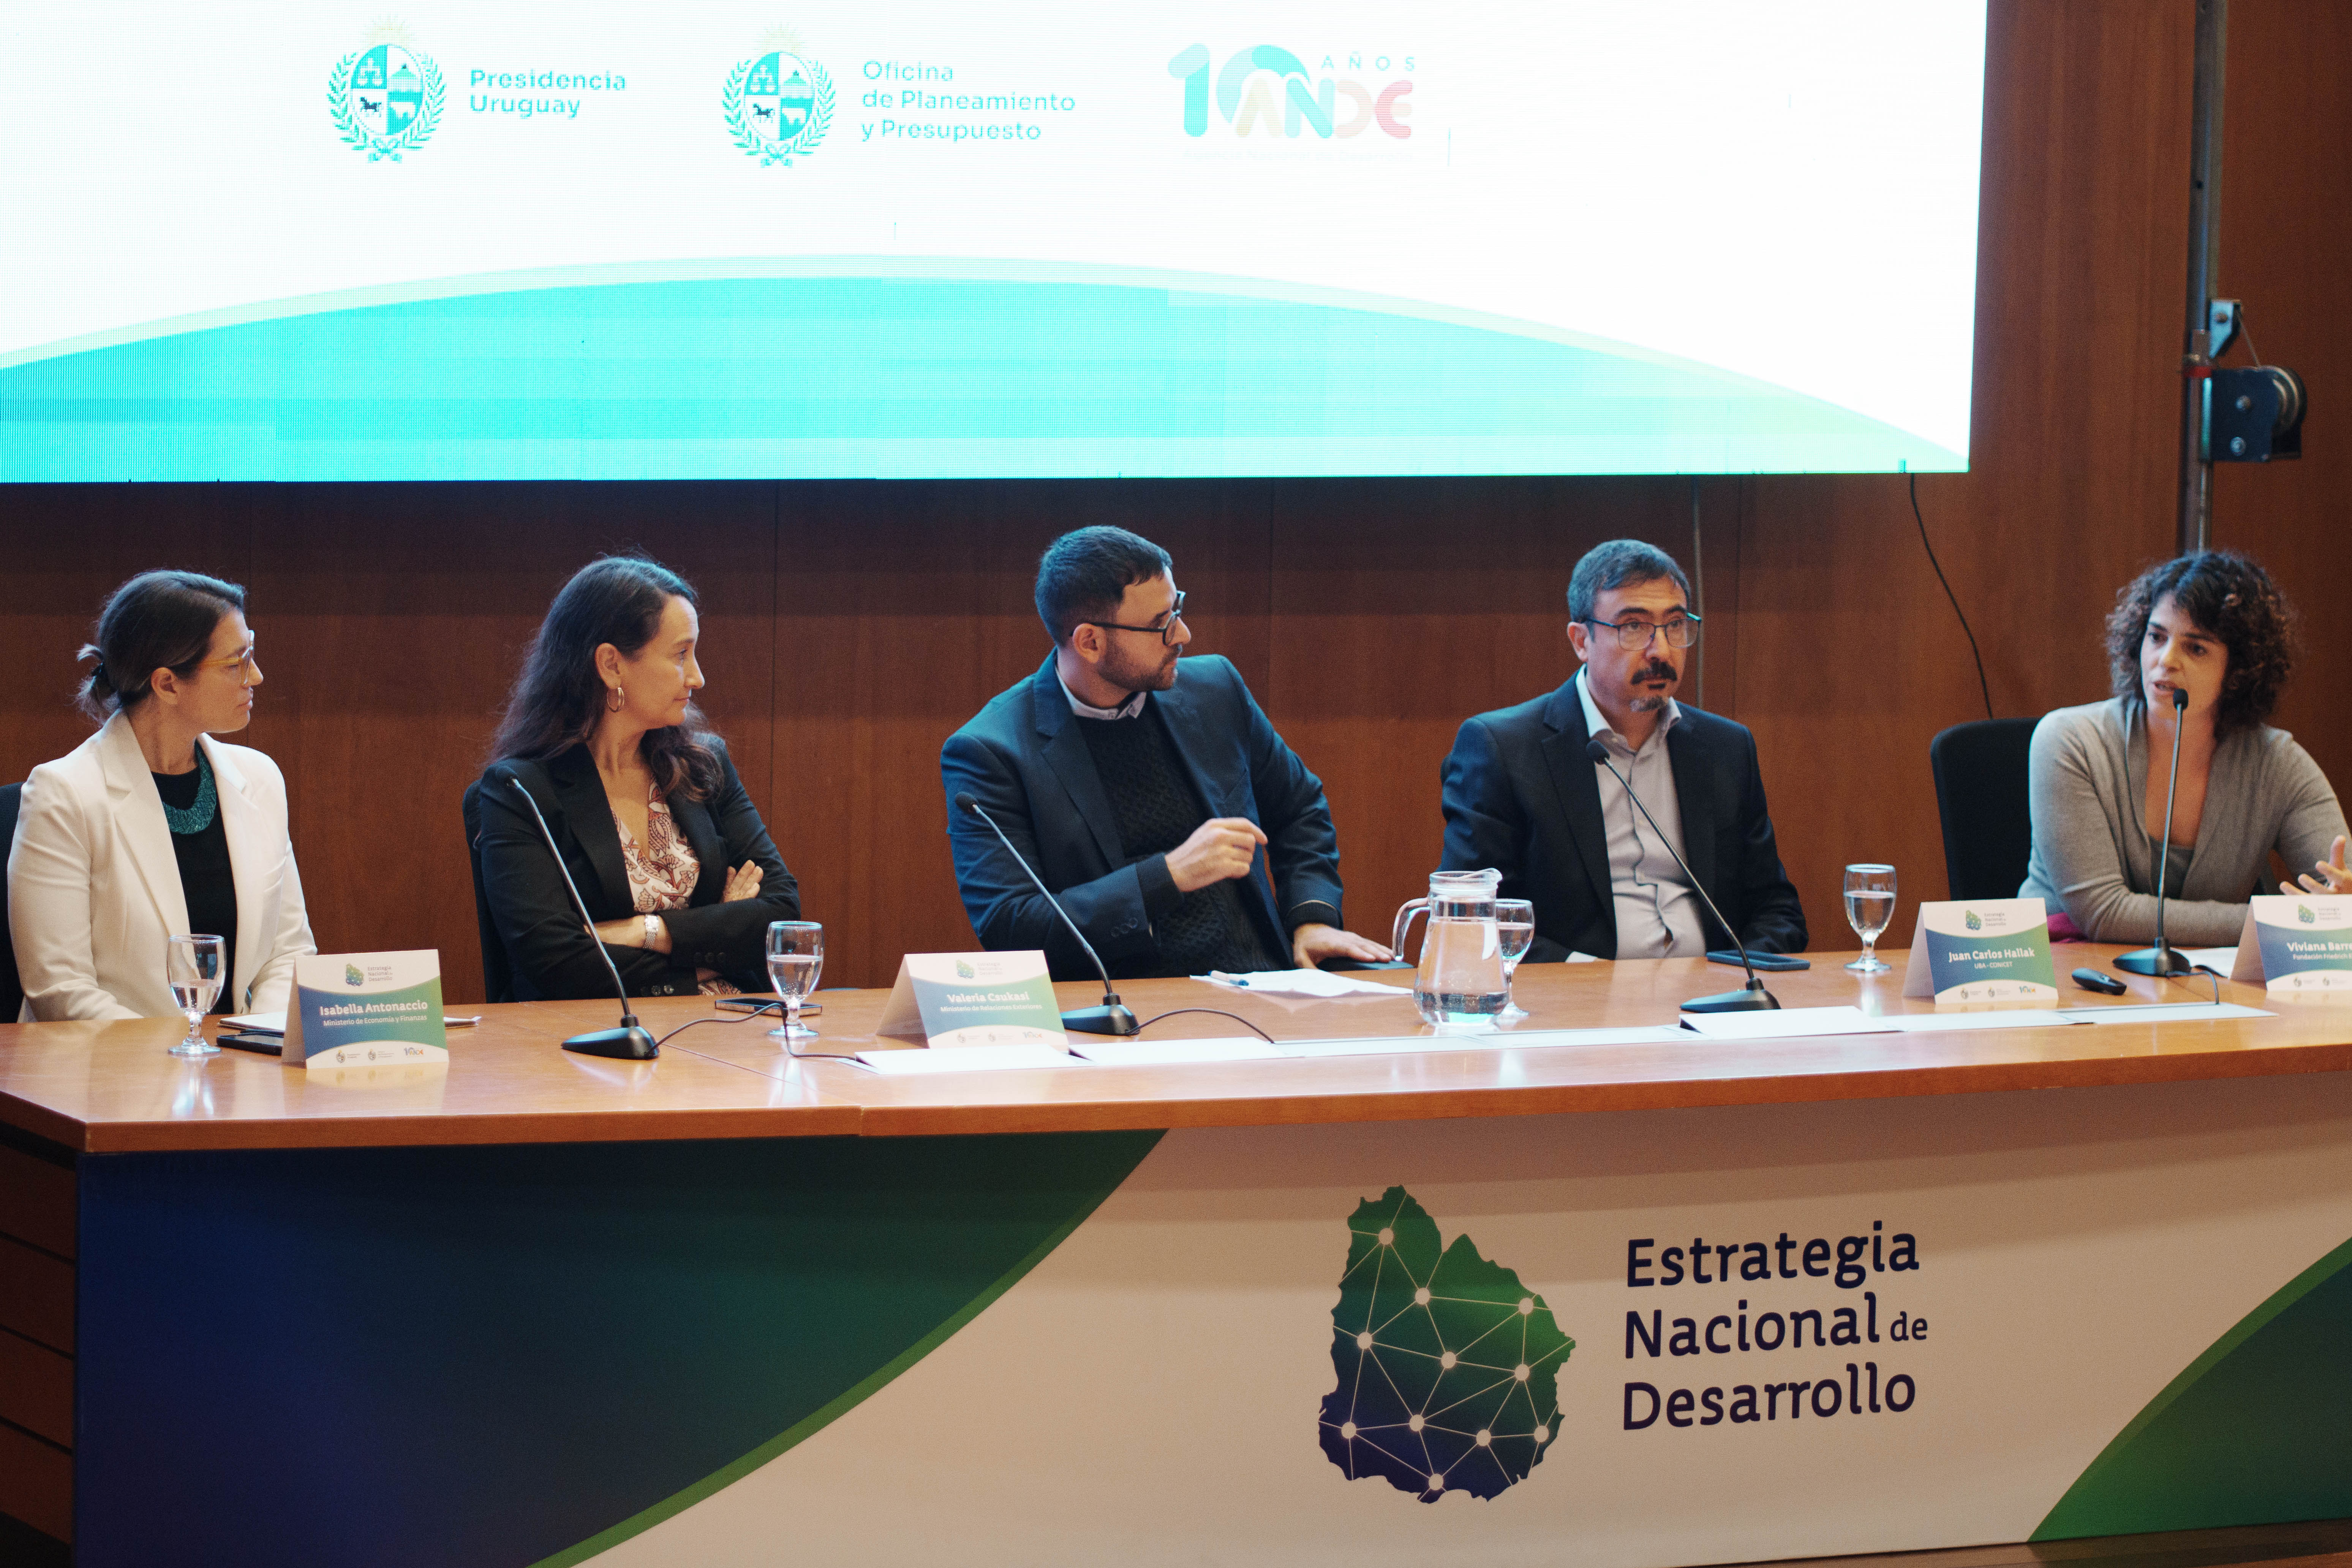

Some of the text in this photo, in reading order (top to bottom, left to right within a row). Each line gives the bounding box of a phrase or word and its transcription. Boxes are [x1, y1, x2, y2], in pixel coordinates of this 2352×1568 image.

[863, 61, 954, 82] Oficina
[1321, 52, 1415, 71] AÑOS
[470, 70, 626, 91] Presidencia
[470, 95, 580, 119] Uruguay
[862, 90, 1076, 111] de Planeamiento
[861, 120, 1042, 142] y Presupuesto
[1949, 947, 2035, 963] Juan Carlos Hallak
[2286, 942, 2327, 952] Viviana
[947, 991, 1030, 1002] Valeria Csukasi
[319, 1000, 428, 1015] Isabella Antonaccio
[1627, 1220, 1919, 1289] Estrategia
[1625, 1291, 1928, 1359] Nacional de
[1623, 1362, 1916, 1430] Desarrollo
